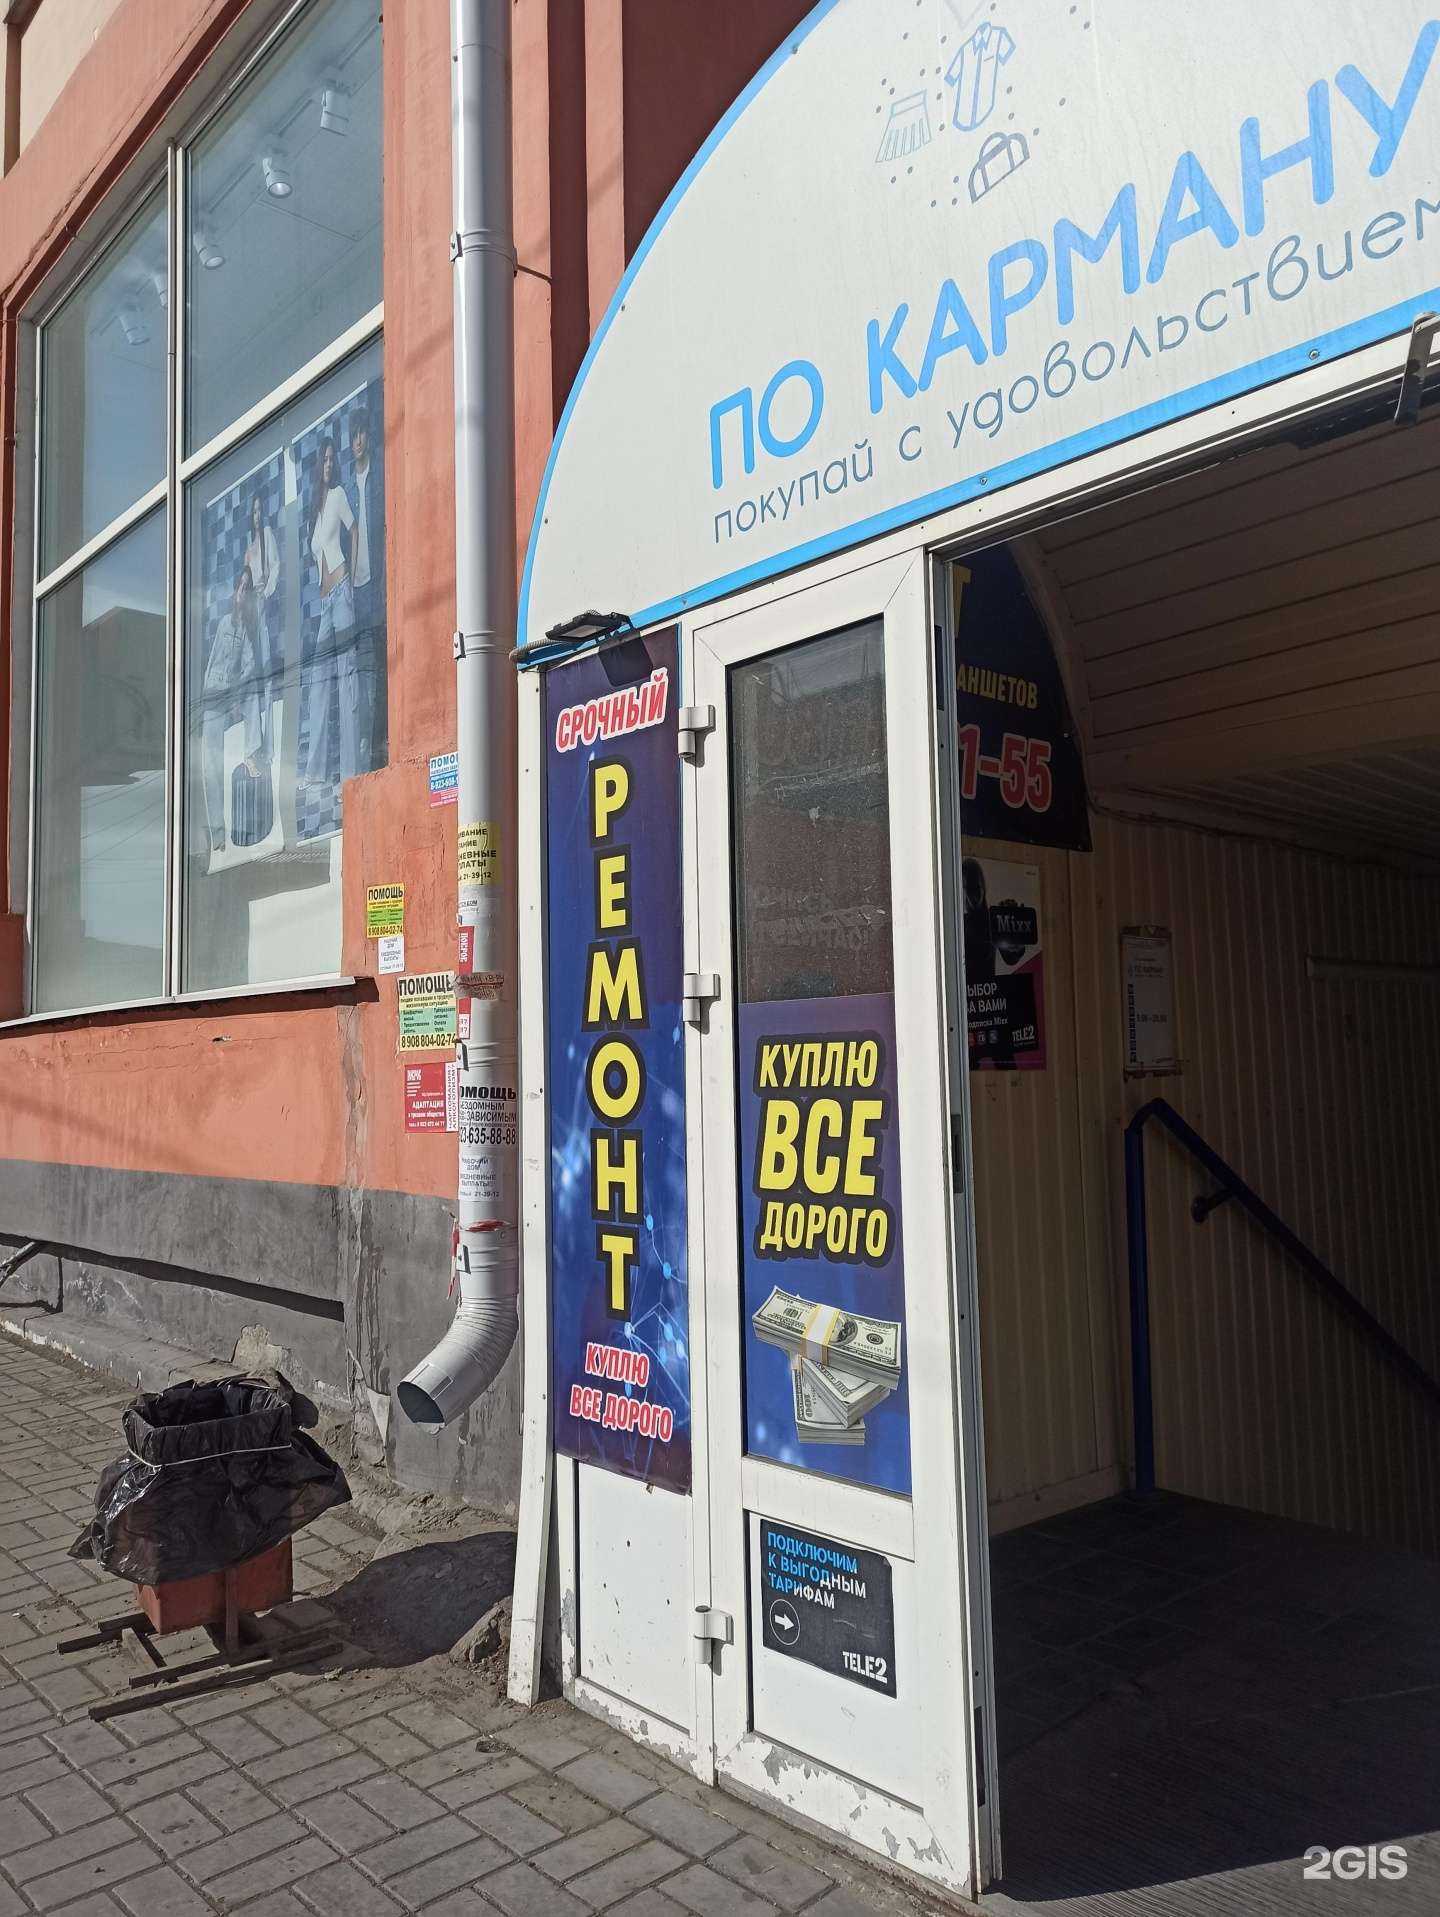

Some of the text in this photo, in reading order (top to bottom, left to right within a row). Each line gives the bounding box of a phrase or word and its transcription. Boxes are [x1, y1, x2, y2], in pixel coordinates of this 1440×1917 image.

[710, 19, 1440, 489] ПО КАРМАНУ
[714, 439, 873, 543] покупай
[899, 425, 922, 461] с
[556, 667, 668, 752] СРОЧНЫЙ
[368, 887, 403, 901] ПОМОЩЬ
[399, 974, 454, 996] ПОМОЩЬ
[978, 997, 1007, 1013] ВАМИ
[401, 1036, 405, 1048] 8
[407, 1035, 420, 1048] 908
[588, 761, 642, 1311] РЕМОНТ
[1012, 1025, 1035, 1043] TELE2
[760, 1040, 878, 1088] КУПЛЮ
[759, 1099, 883, 1195] ВСЕ
[760, 1202, 888, 1258] ДОРОГО
[584, 1341, 650, 1388] КУПЛЮ
[569, 1384, 673, 1442] ВСЕ ДОРОГО
[767, 1531, 858, 1575] ПОДКЛЮЧИМ
[768, 1552, 867, 1599] К ВЫГОДНЫМ
[768, 1572, 835, 1609] ТАРИФАМ
[842, 1650, 888, 1684] TELE2
